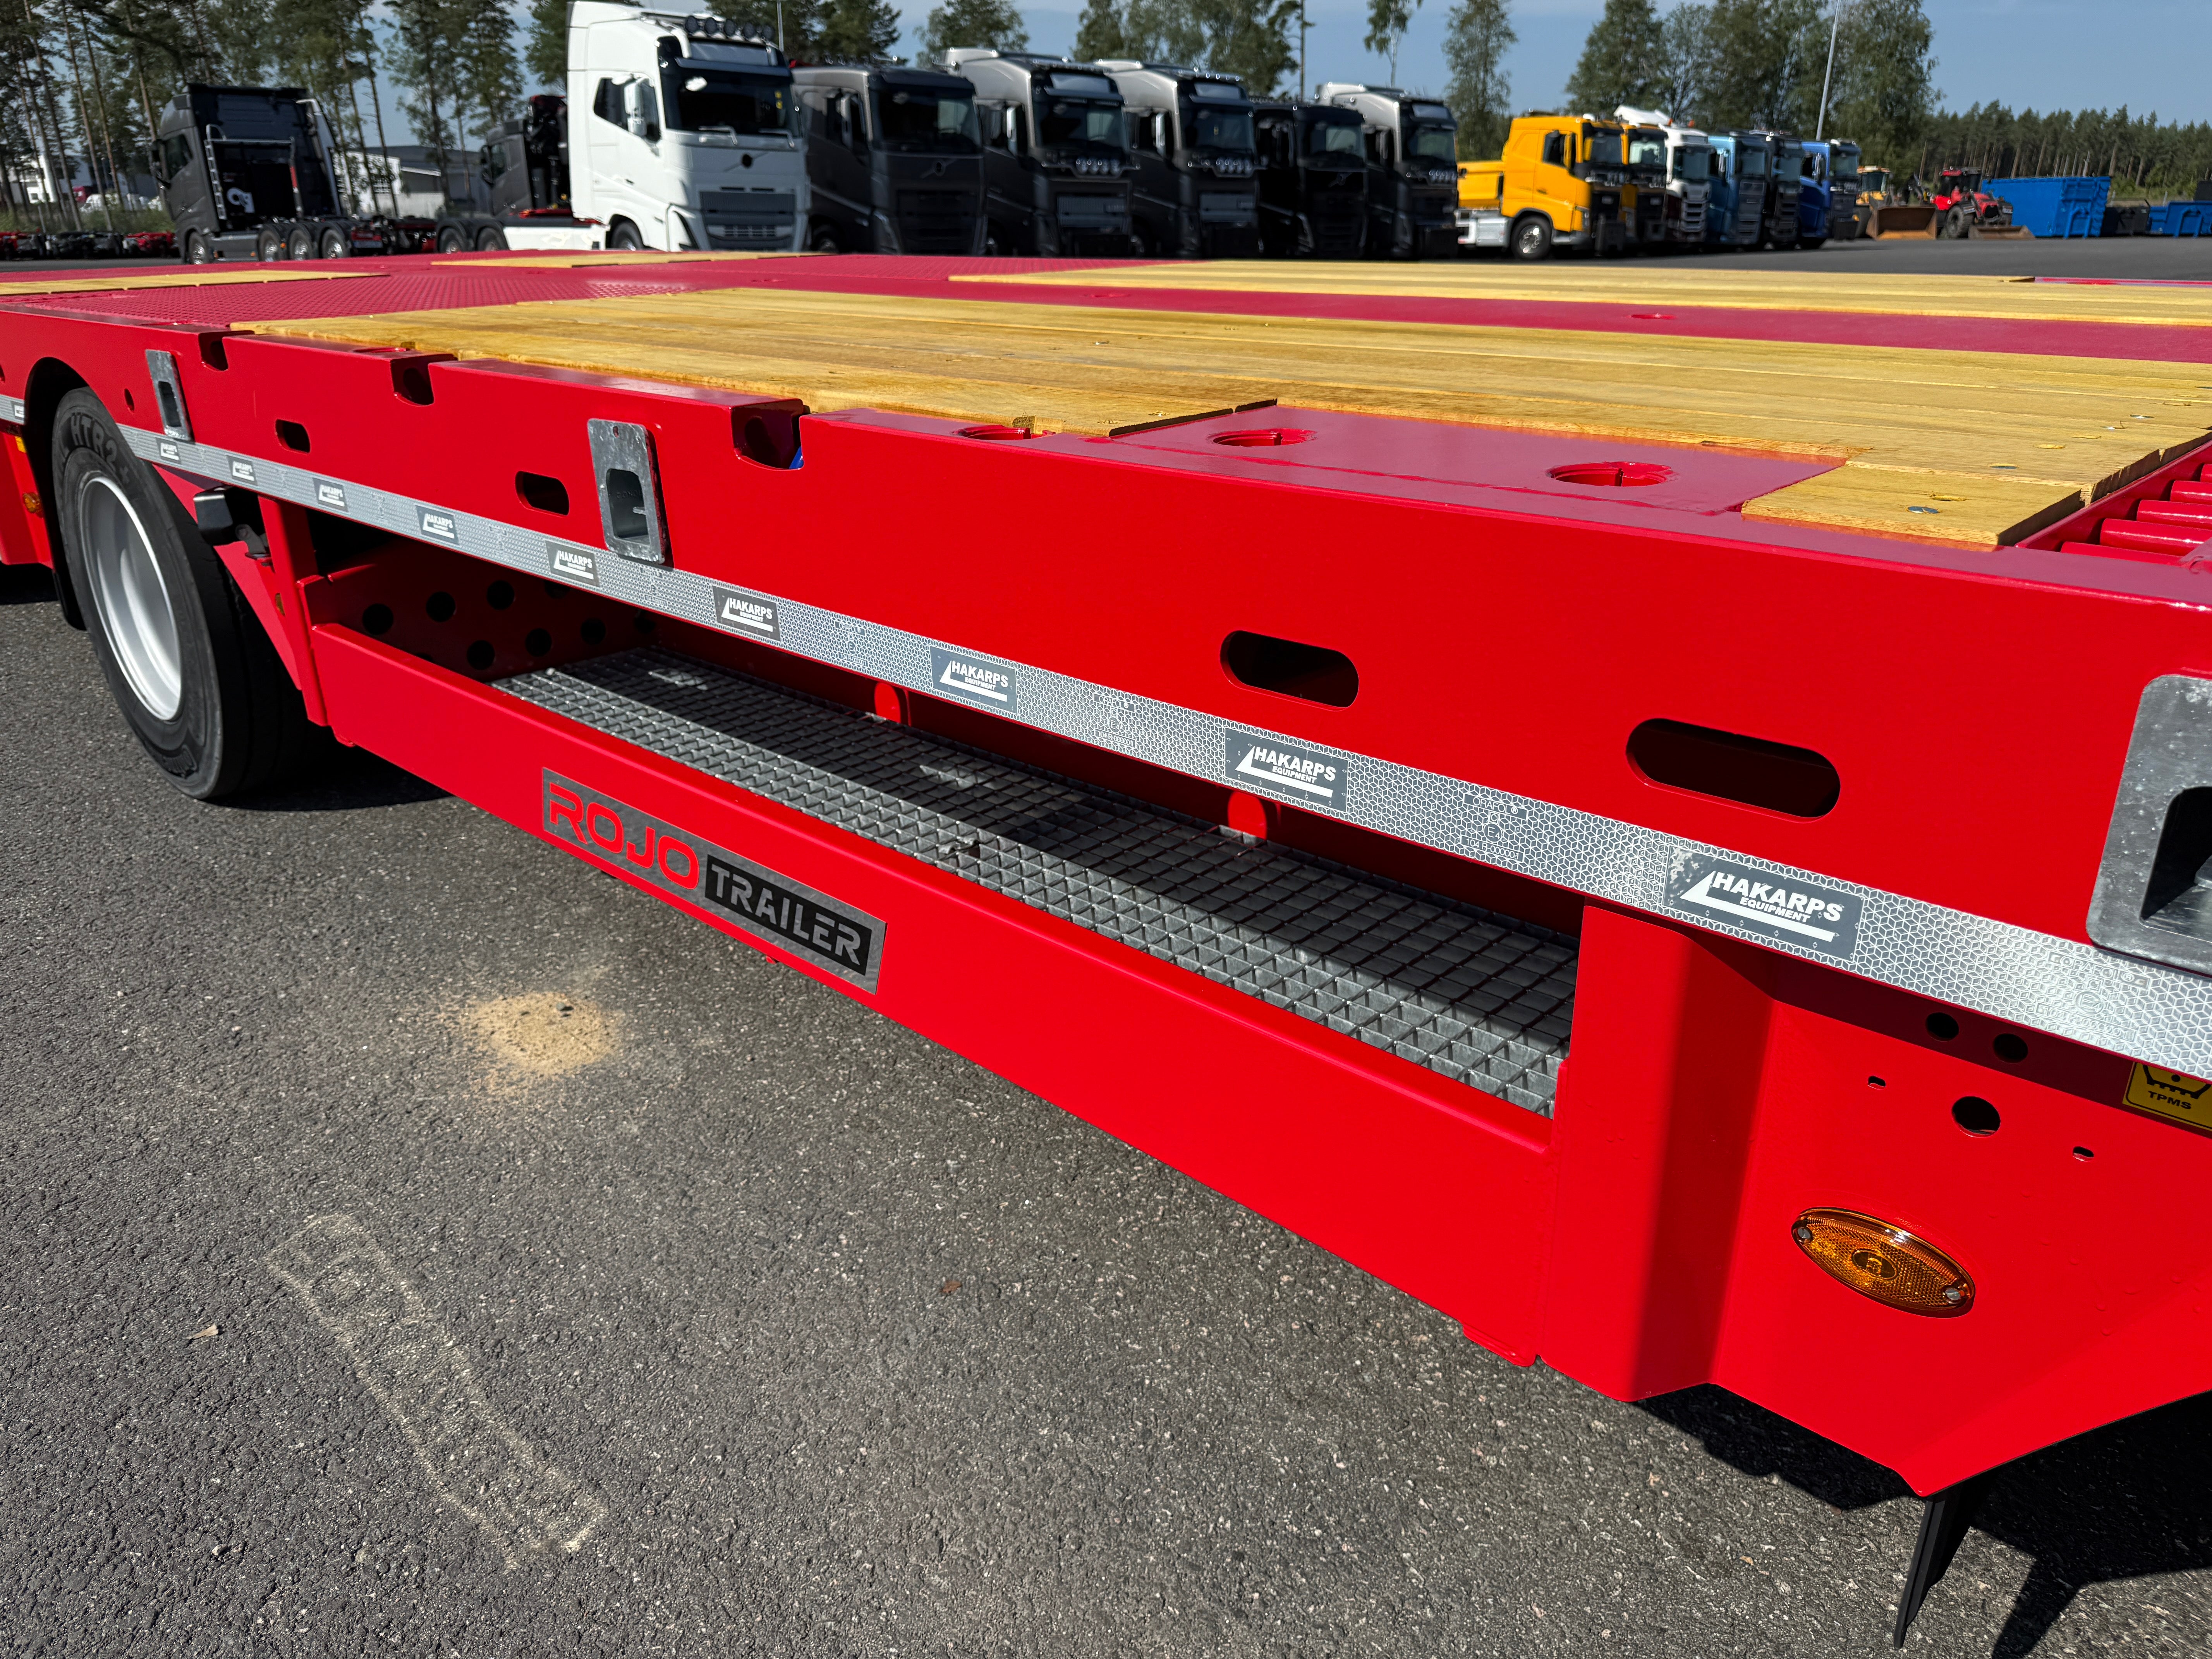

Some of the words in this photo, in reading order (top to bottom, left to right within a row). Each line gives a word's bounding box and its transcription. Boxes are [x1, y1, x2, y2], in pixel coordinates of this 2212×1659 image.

[559, 550, 592, 568] HAKARPS
[730, 598, 772, 619] HAKARPS
[952, 661, 1008, 687] HAKARPS
[965, 677, 996, 690] EQUIPMENT
[1254, 747, 1336, 781] HAKARPS
[1272, 766, 1317, 783] EQUIPMENT
[1473, 798, 1510, 815] ORAFOL
[550, 783, 699, 890] ROJO
[1467, 838, 1479, 848] 104
[1712, 872, 1844, 922] HAKARPS
[711, 864, 860, 965] TRAILER
[1740, 897, 1810, 922] EQUIPMENT
[2061, 957, 2120, 982] ORAFOL
[2148, 1091, 2191, 1109] TPMS
